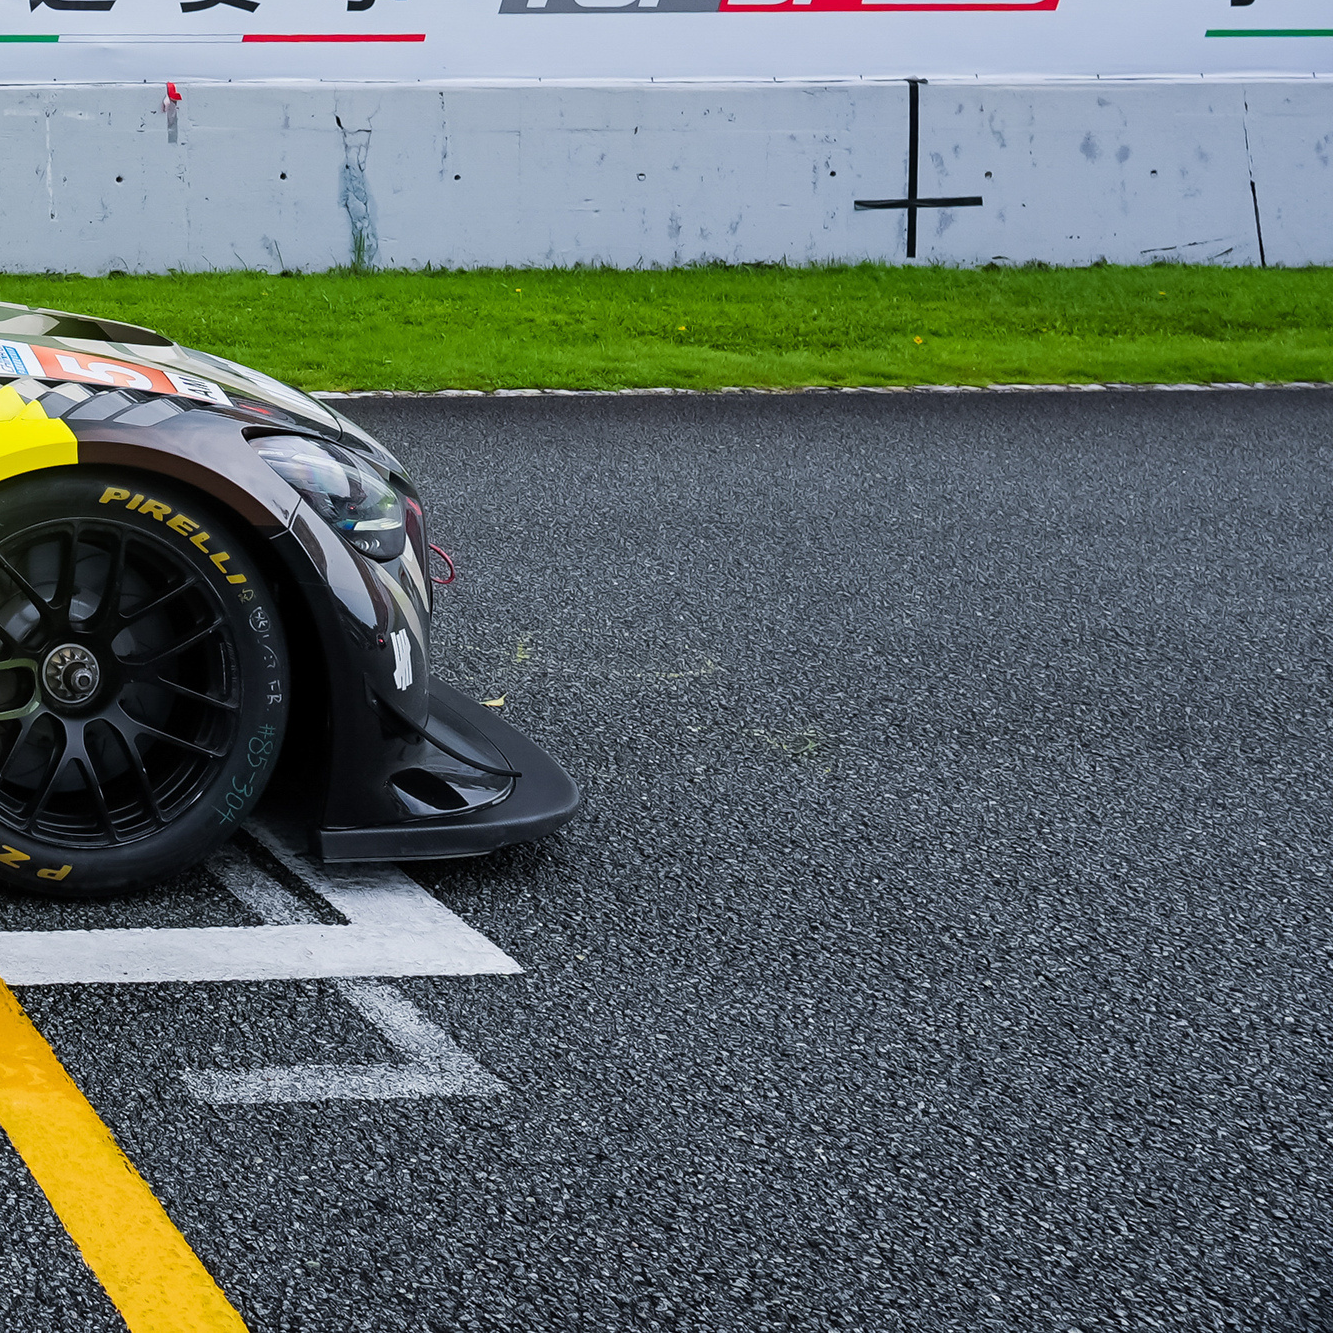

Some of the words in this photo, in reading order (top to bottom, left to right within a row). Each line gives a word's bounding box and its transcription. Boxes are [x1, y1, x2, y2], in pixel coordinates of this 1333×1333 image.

[98, 486, 248, 585] PIRELLI
[212, 723, 276, 825] #85-304
[35, 863, 73, 882] P
